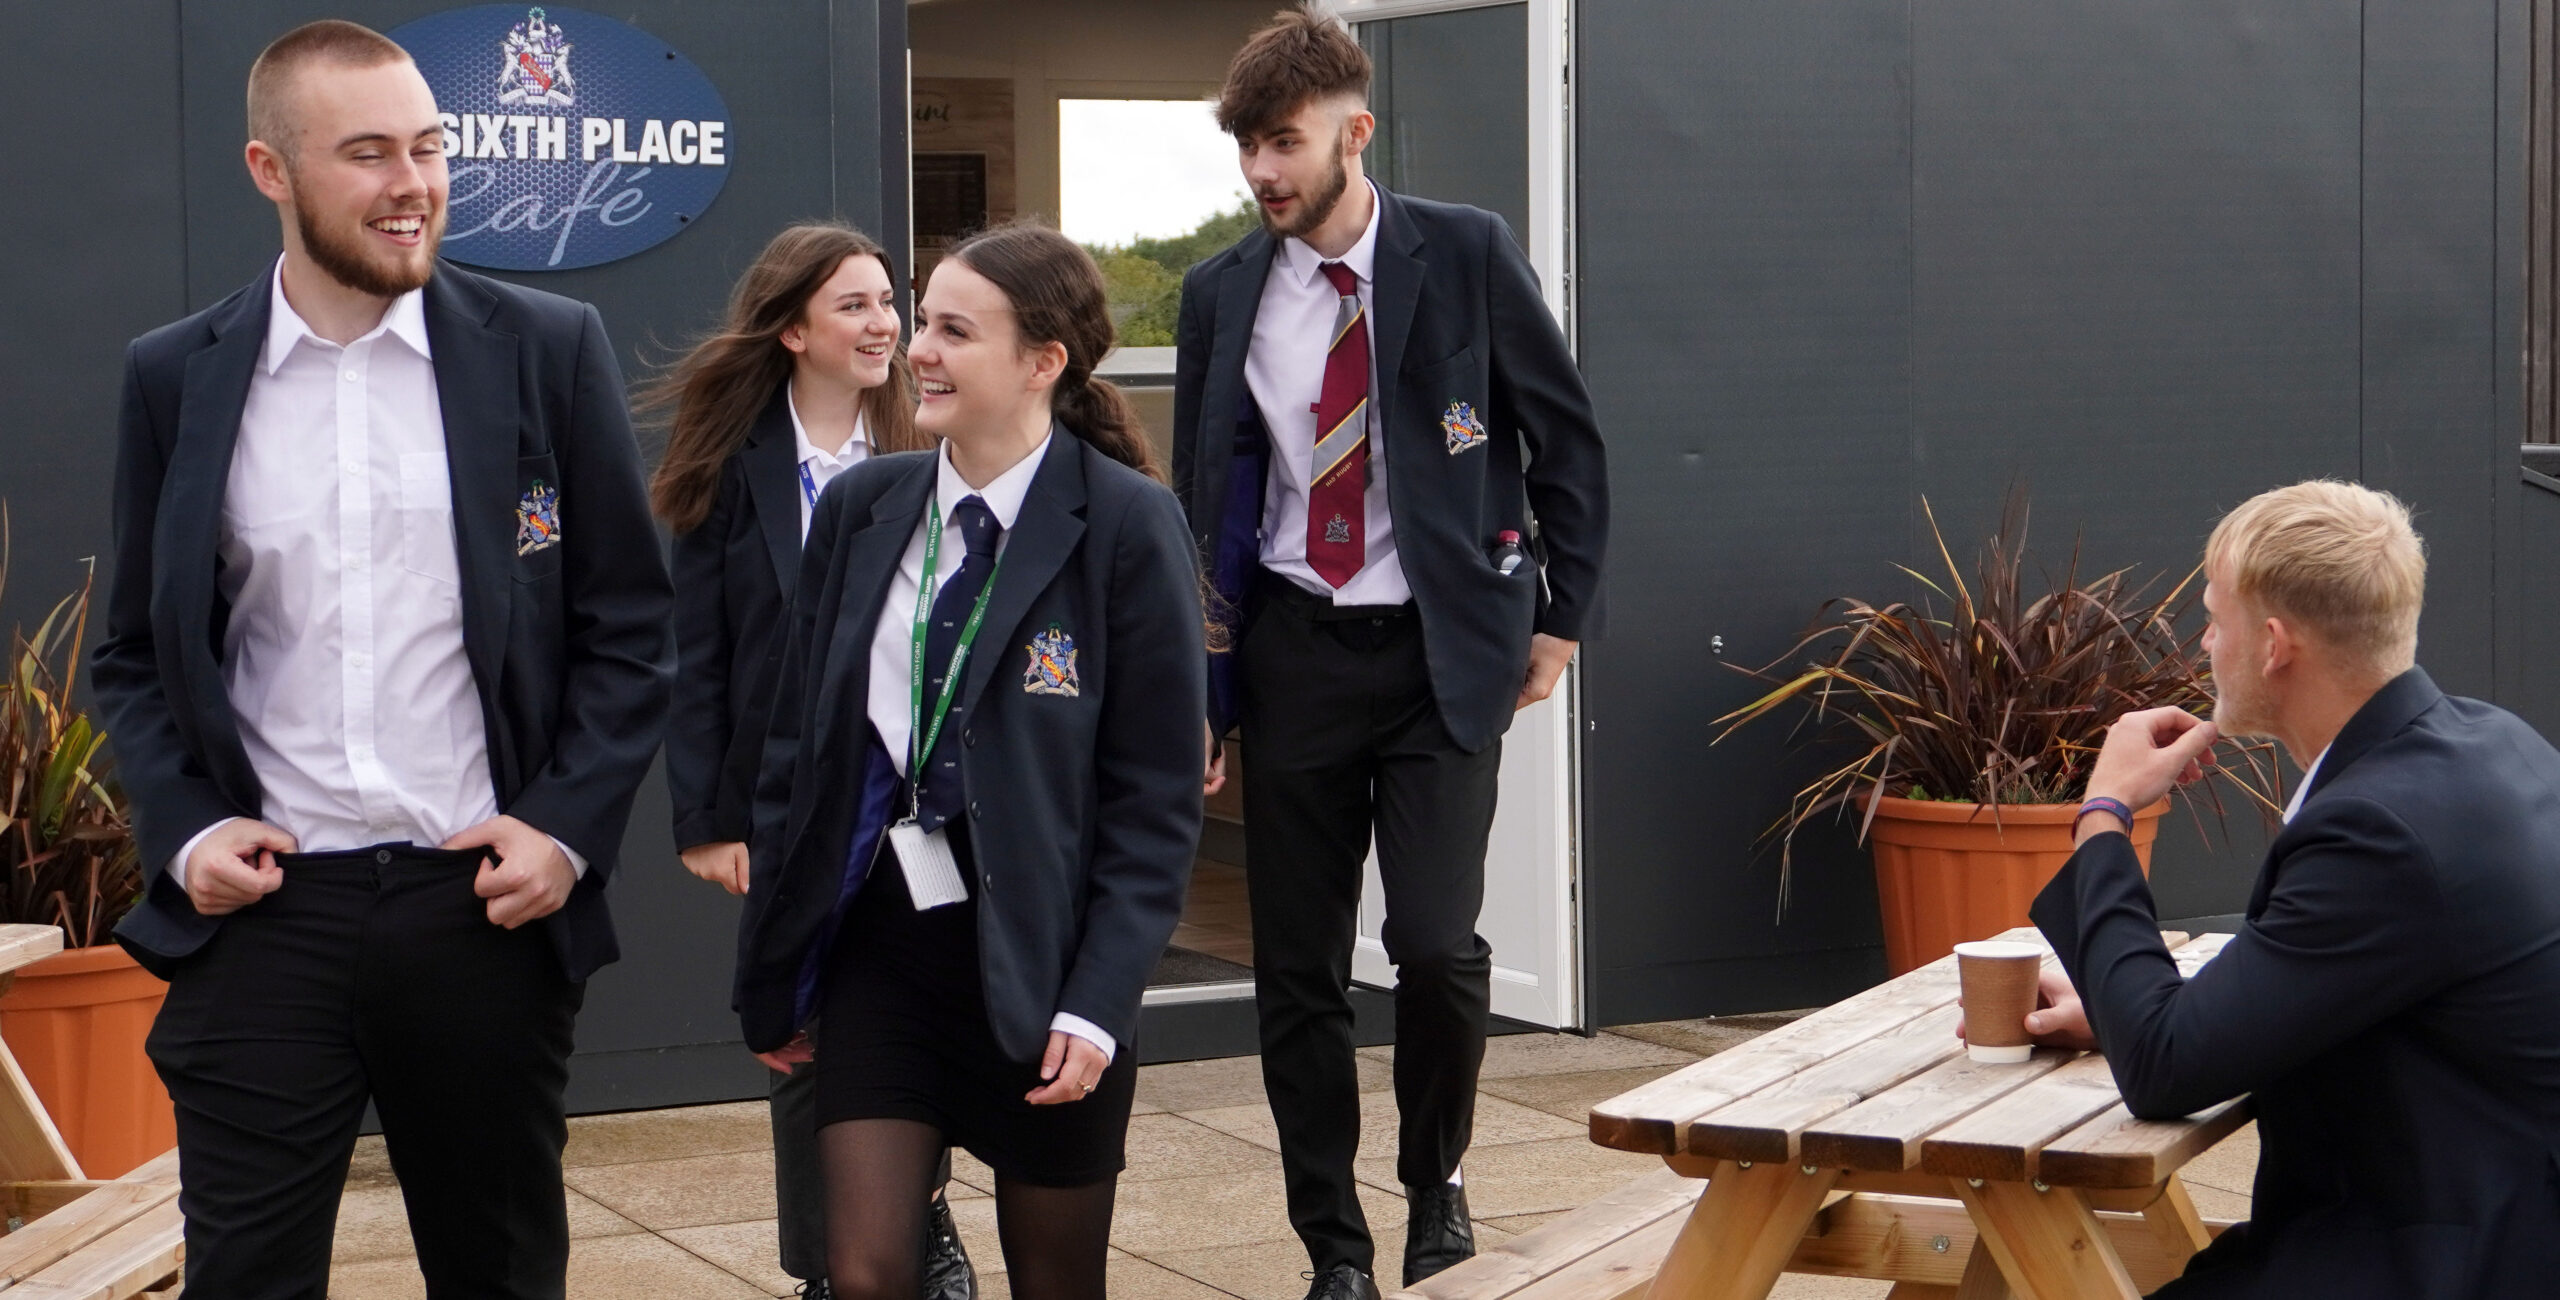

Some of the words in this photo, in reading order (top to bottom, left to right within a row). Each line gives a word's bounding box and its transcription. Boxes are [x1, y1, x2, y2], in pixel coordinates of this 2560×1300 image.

[440, 112, 567, 161] SIXTH
[582, 117, 726, 166] PLACE
[441, 157, 653, 267] Café
[931, 517, 939, 538] FORM
[927, 537, 936, 558] SIXTH
